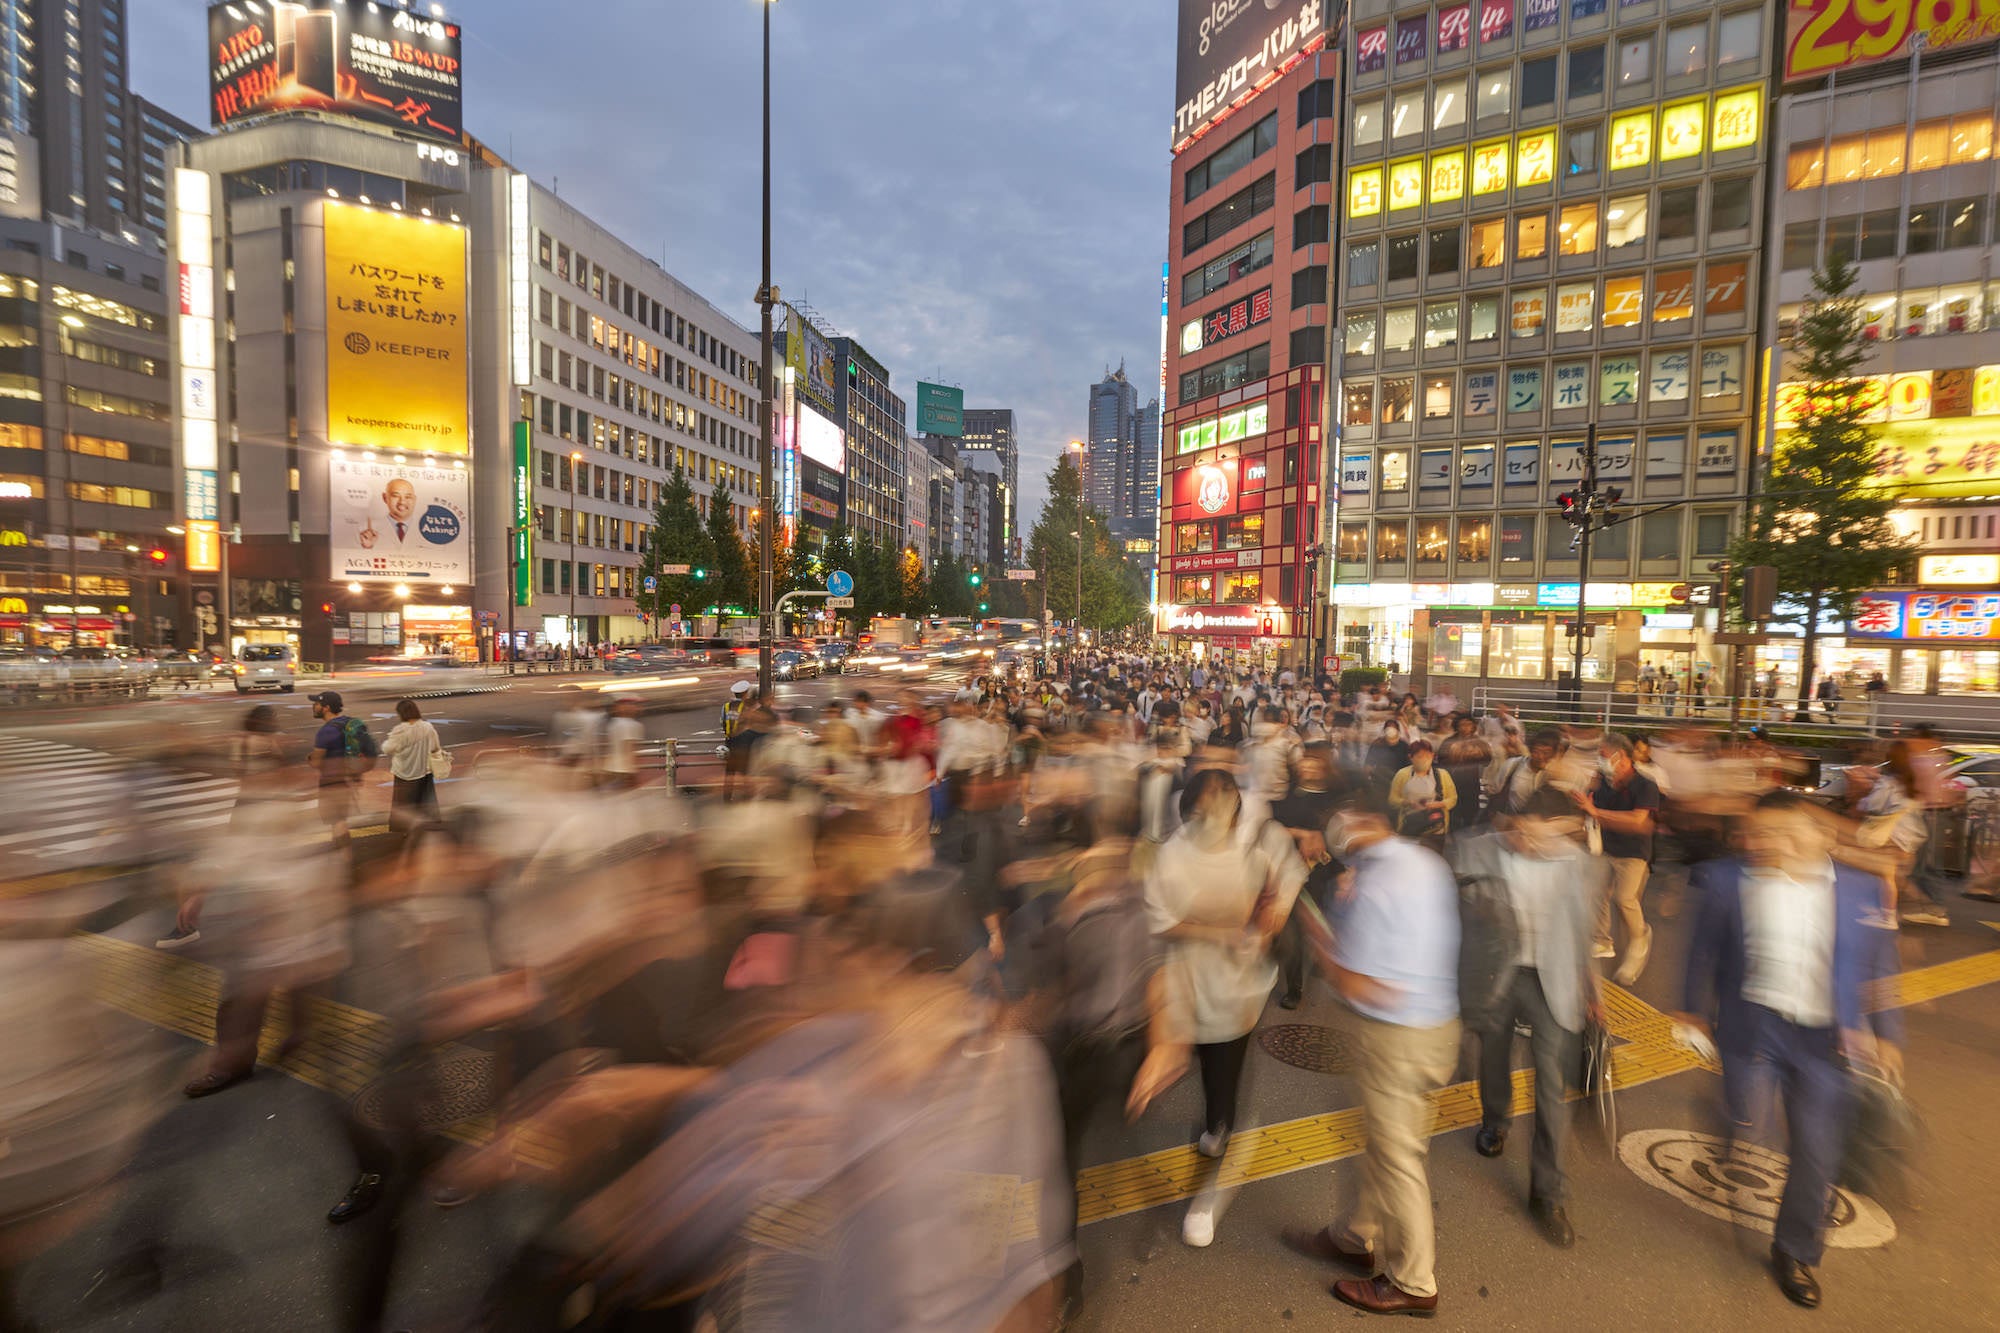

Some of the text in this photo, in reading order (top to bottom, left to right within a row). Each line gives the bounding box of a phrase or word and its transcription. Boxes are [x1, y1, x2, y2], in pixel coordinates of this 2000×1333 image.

[219, 24, 262, 65] AIKO
[416, 142, 459, 166] FPG
[350, 263, 446, 290] パスワードを
[375, 285, 423, 304] 忘れて
[337, 296, 457, 326] しまいましたか?
[1209, 289, 1271, 342] 大黒屋
[375, 341, 450, 361] KEEPER
[346, 415, 453, 436] keepersecurity.jp
[345, 558, 372, 568] AGA
